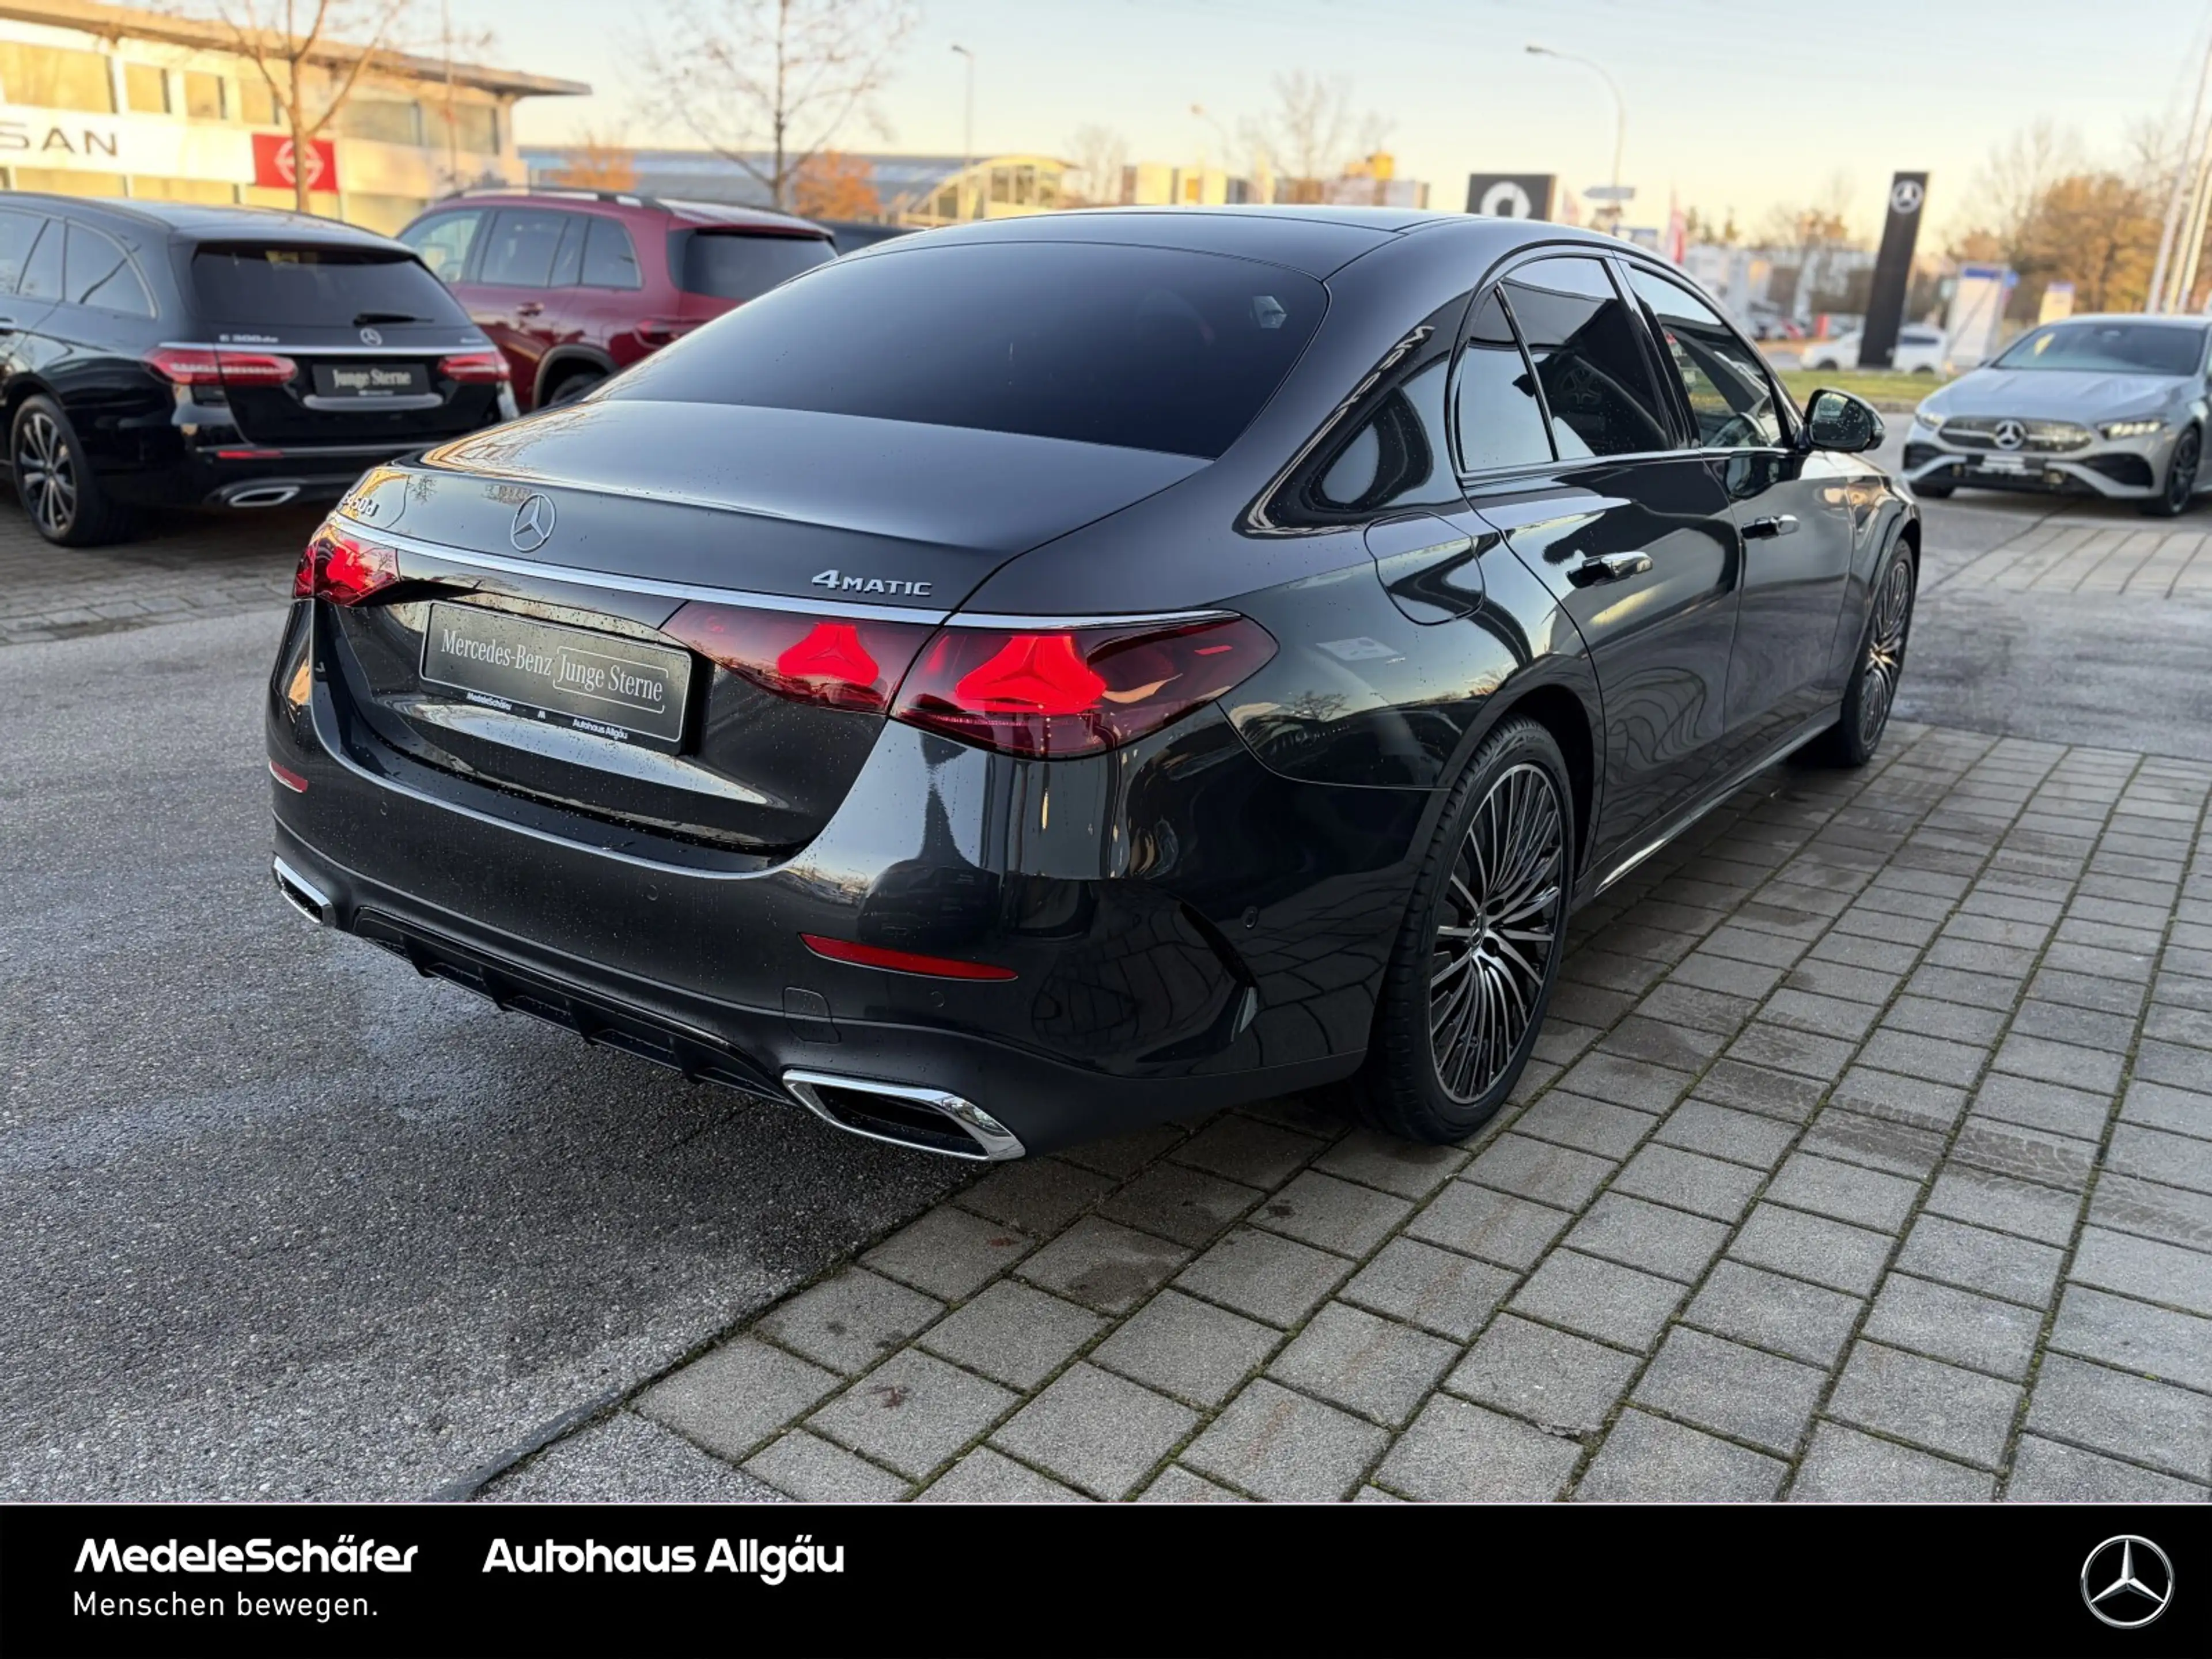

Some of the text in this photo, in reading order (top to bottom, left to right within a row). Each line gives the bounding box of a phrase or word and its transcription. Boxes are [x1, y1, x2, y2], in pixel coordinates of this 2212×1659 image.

[333, 368, 411, 389] Junge Sterne
[811, 569, 932, 596] 4MATIC
[441, 629, 664, 702] Mercedes-Benz Junge Sterne
